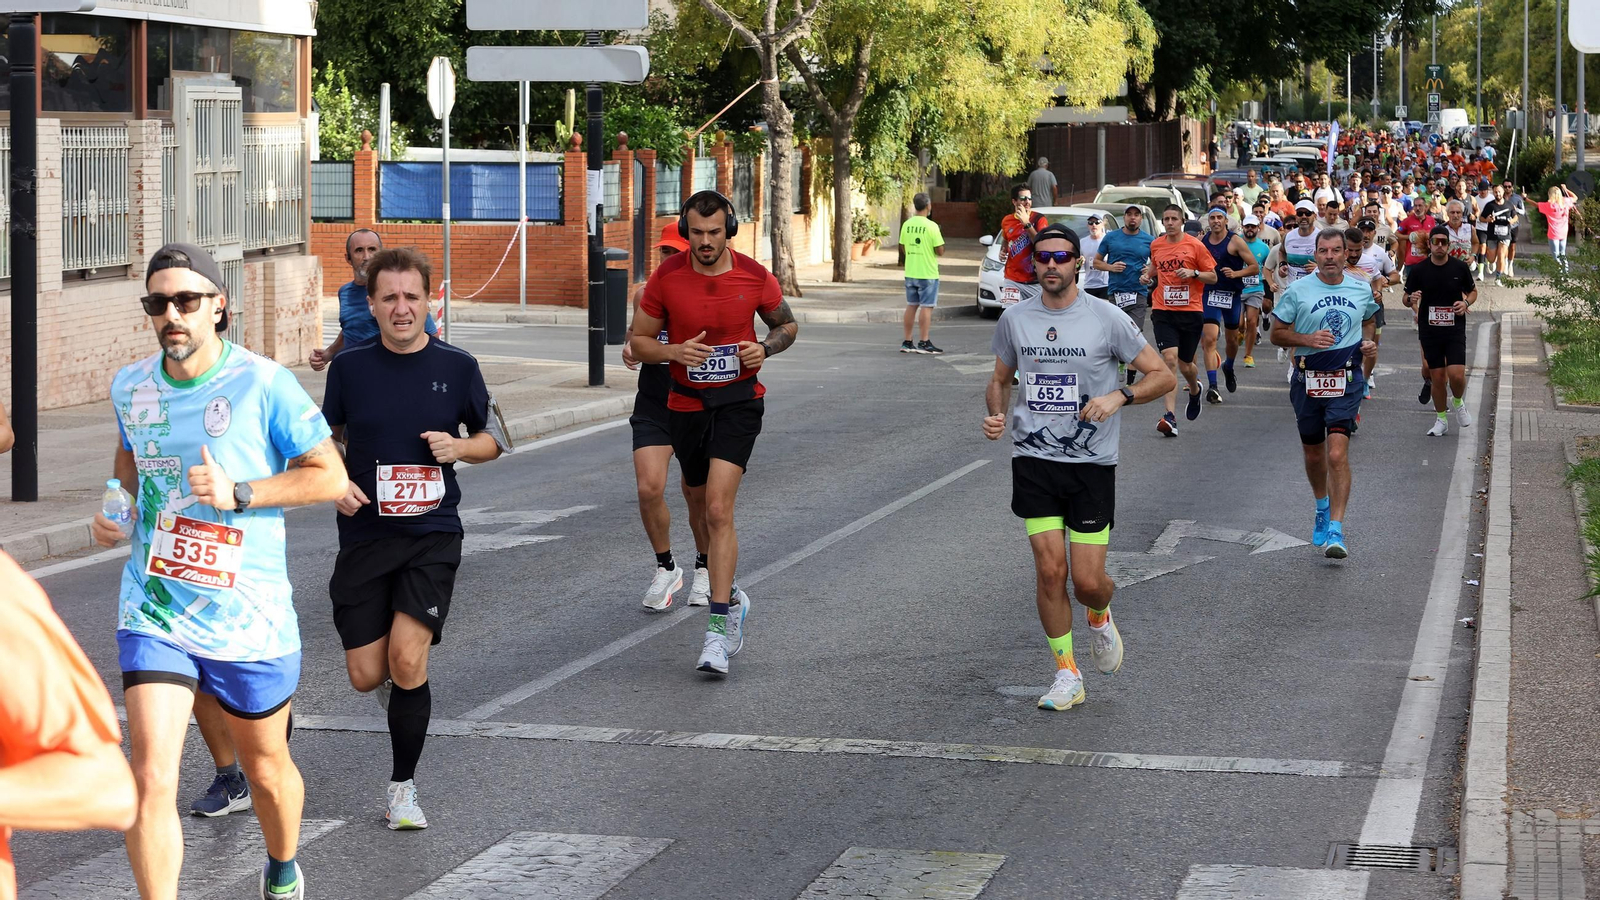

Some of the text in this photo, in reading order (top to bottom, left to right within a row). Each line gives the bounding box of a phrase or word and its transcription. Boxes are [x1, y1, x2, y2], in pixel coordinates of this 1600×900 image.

[907, 226, 926, 234] STAFF
[1021, 346, 1087, 357] PINTAMONA
[700, 358, 727, 371] 590
[1316, 379, 1336, 388] 160
[1037, 387, 1065, 400] 652
[137, 459, 176, 468] ATLETISMO
[394, 482, 427, 499] 271
[173, 538, 218, 566] 535
